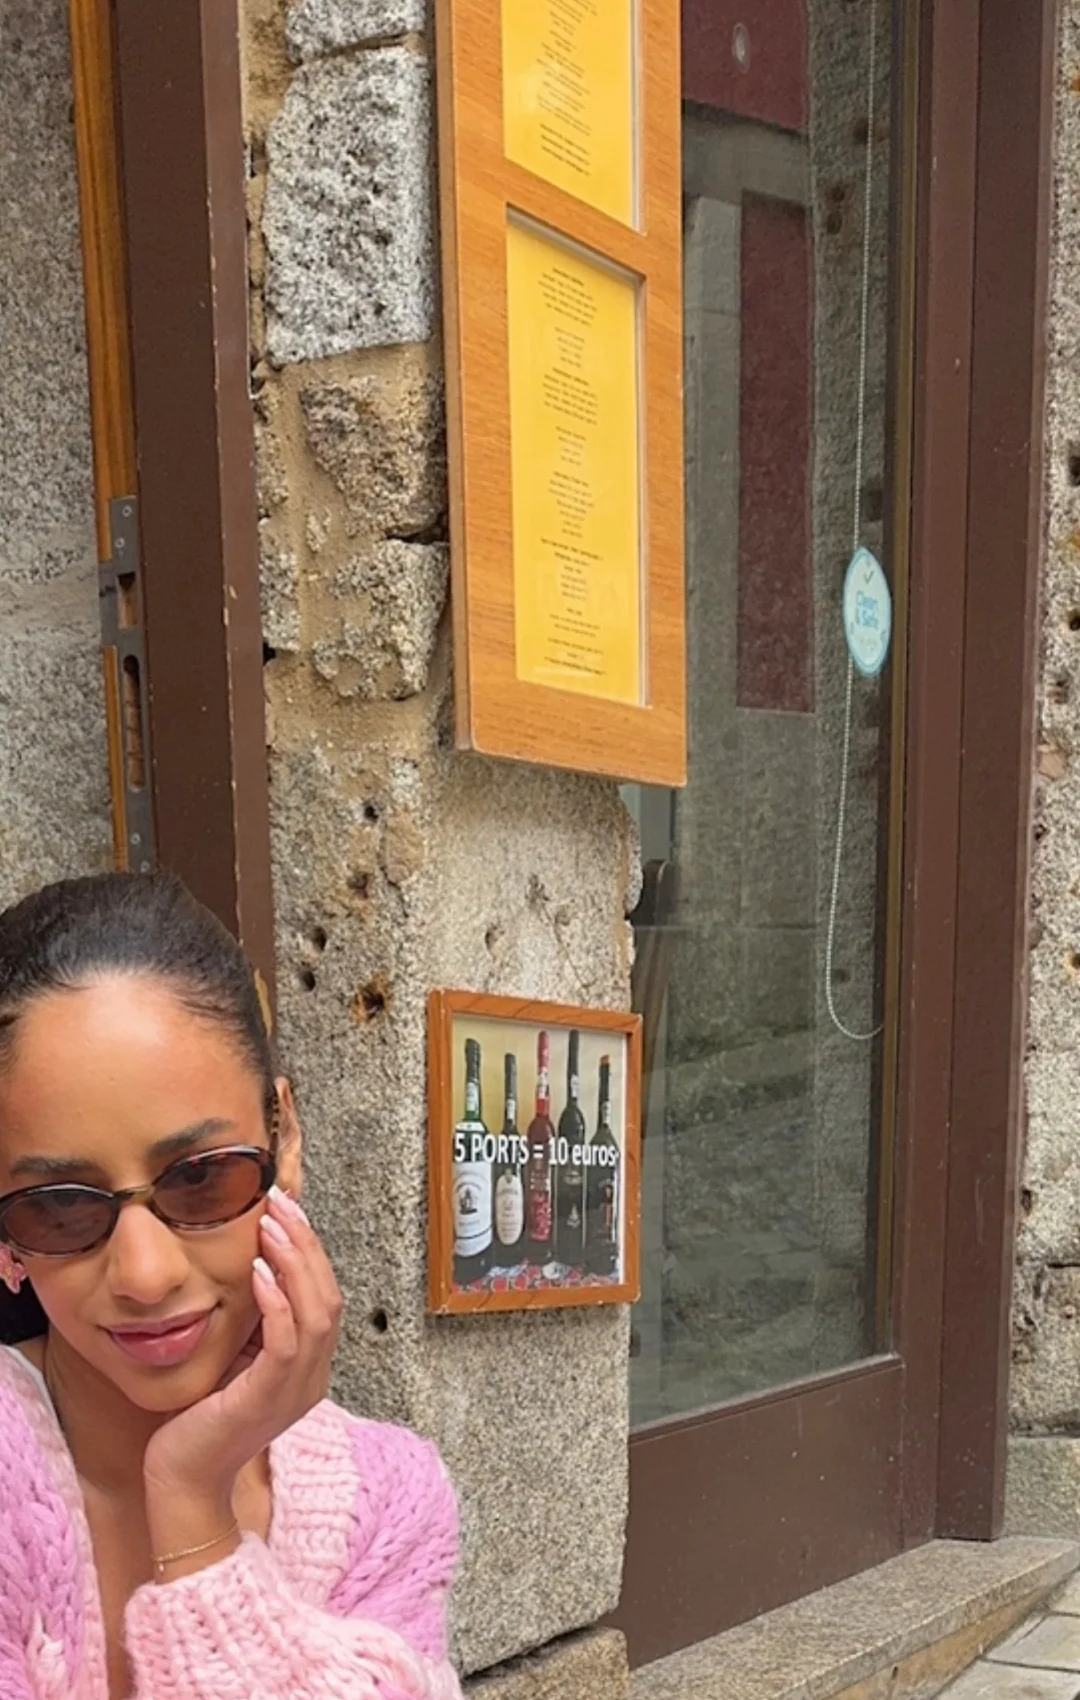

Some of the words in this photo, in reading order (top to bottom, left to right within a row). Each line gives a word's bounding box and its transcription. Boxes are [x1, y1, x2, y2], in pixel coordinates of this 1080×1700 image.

[454, 1132, 466, 1162] 5
[471, 1133, 530, 1165] PORTS
[533, 1144, 544, 1158] =
[548, 1136, 568, 1166] 10
[572, 1144, 616, 1167] euros
